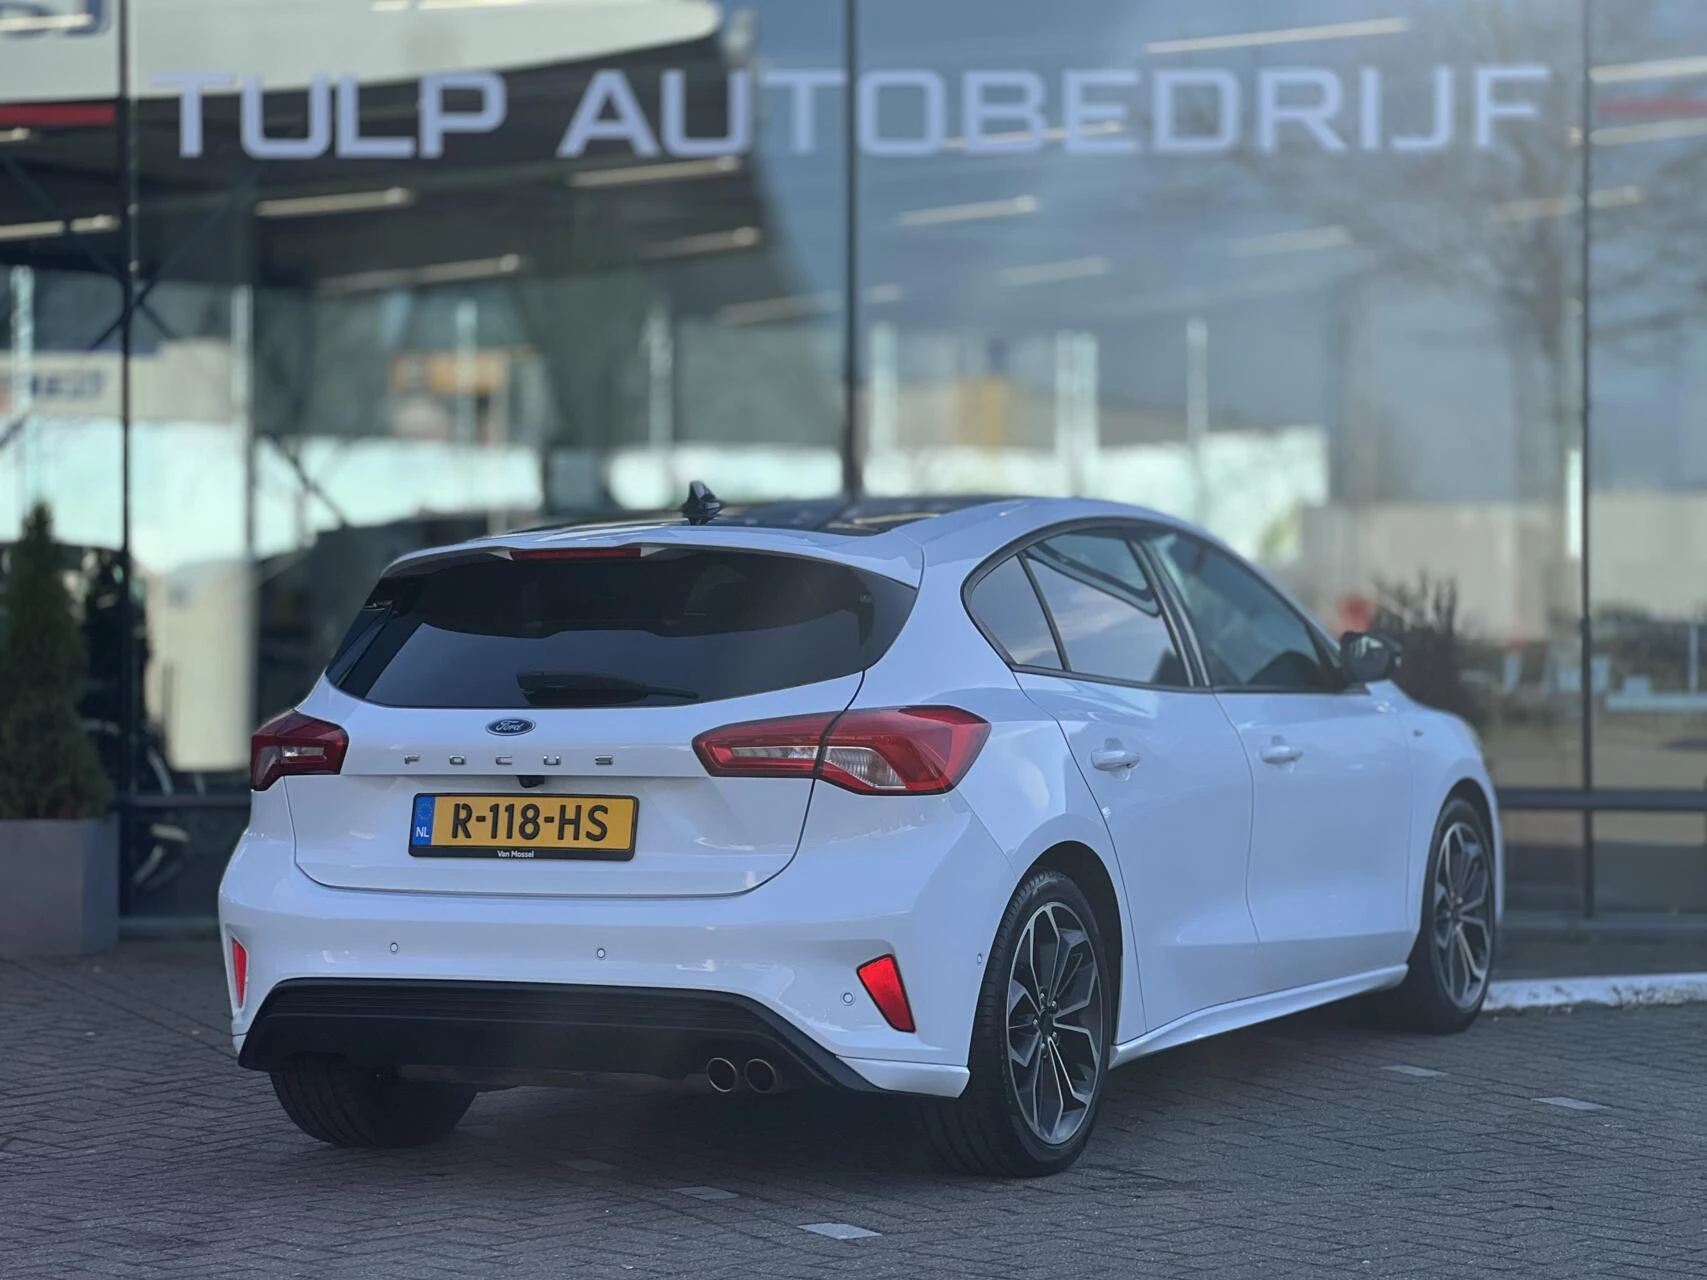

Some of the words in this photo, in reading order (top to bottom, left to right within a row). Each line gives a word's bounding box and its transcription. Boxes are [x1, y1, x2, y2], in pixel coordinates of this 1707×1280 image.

[154, 70, 508, 160] TULP
[556, 64, 1550, 160] AUTOBEDRIJF
[496, 720, 525, 731] Ford
[404, 754, 613, 766] FOCUS
[451, 803, 609, 842] R-118-HS
[416, 827, 429, 838] NL
[497, 850, 510, 858] Van
[511, 850, 535, 859] Mossel
